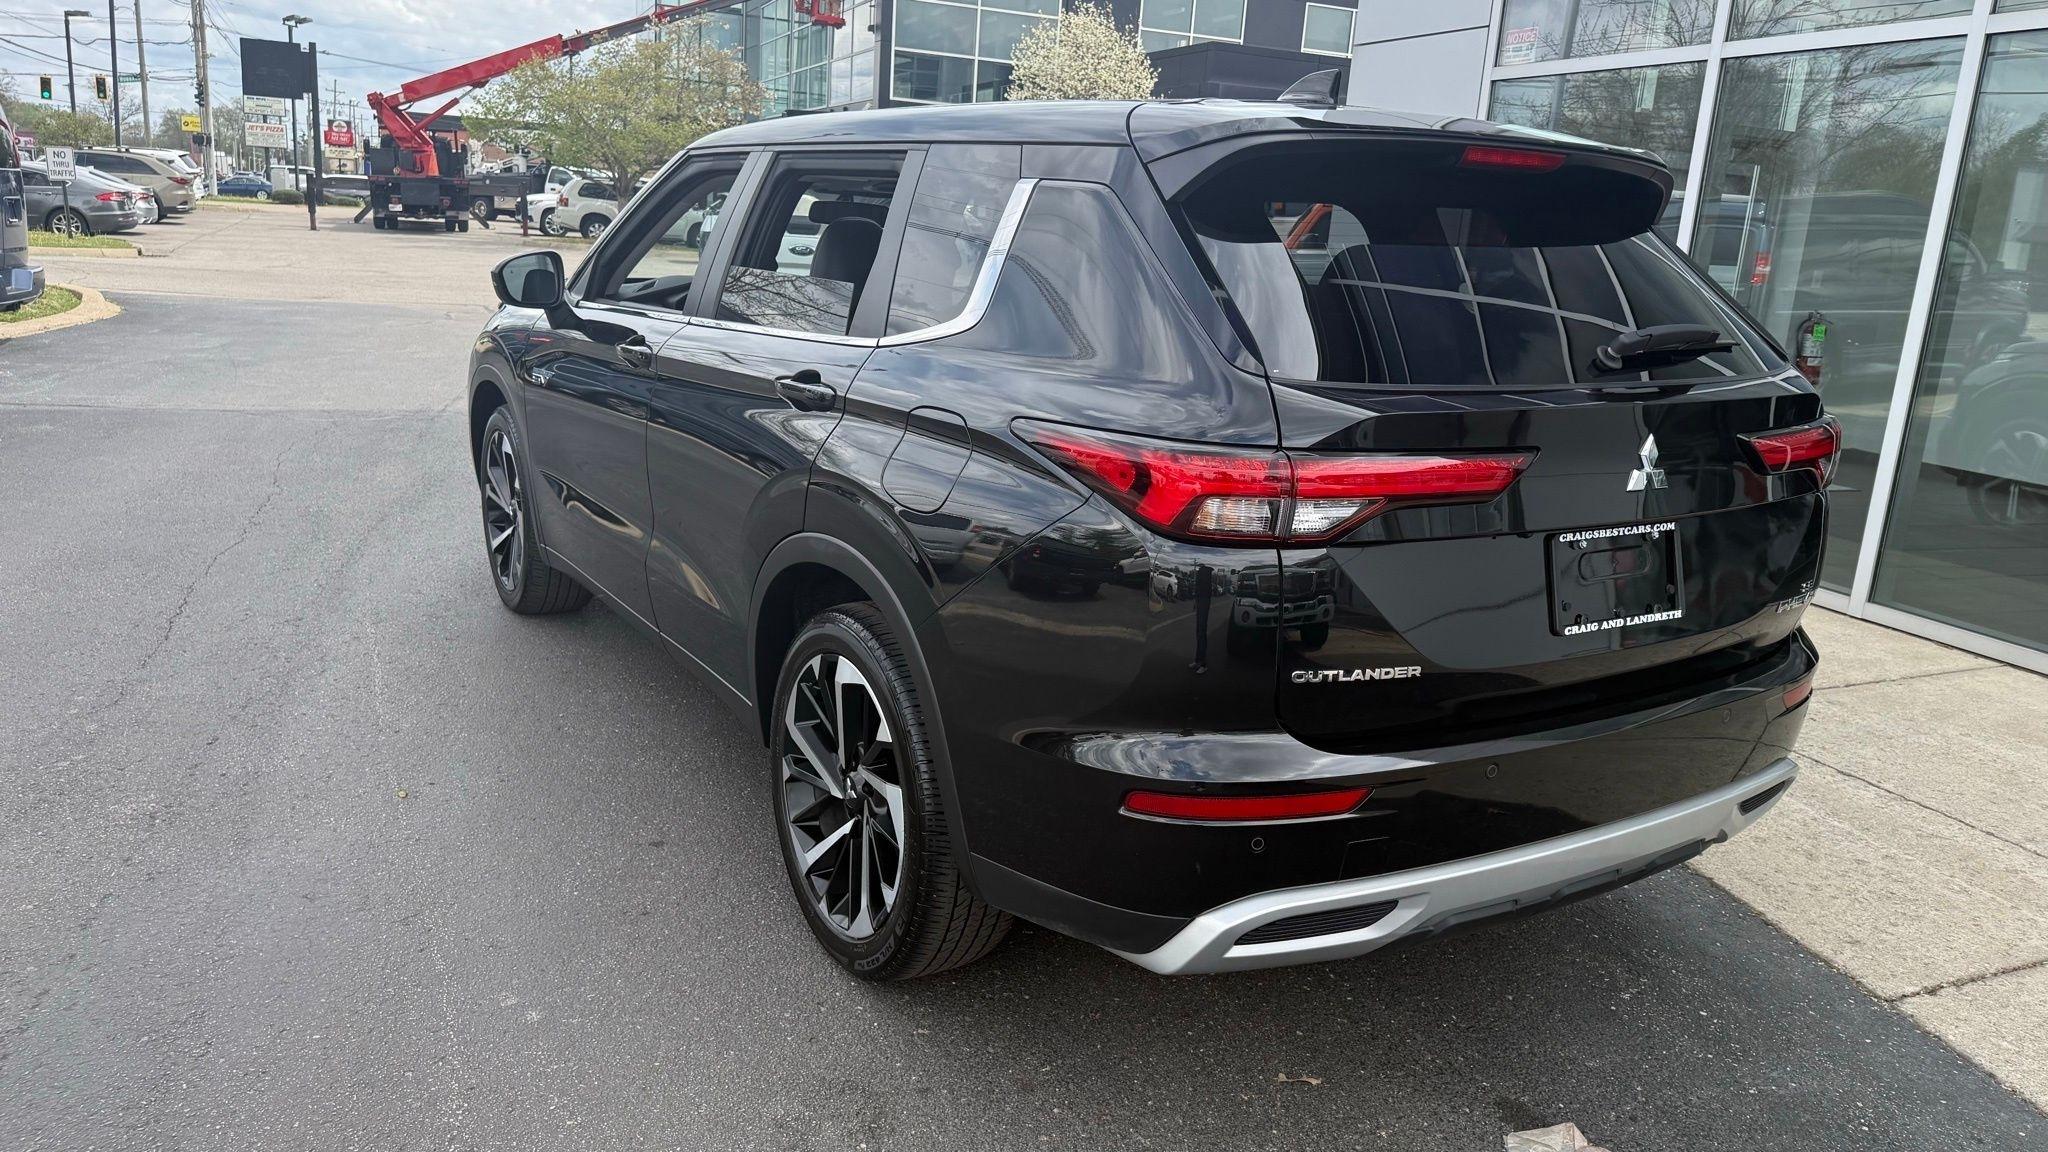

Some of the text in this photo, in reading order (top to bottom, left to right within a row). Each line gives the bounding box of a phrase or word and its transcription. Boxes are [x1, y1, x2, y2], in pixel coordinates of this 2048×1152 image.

[1506, 30, 1537, 44] NOTICE
[52, 150, 66, 159] NO
[52, 160, 69, 168] THRU
[49, 169, 74, 177] TRAFFIC
[1559, 522, 1676, 542] CRAIGSBESTCARS.COM
[1564, 609, 1682, 635] CRAIG AND LANDRETH
[1291, 666, 1422, 684] OUTLANDER
